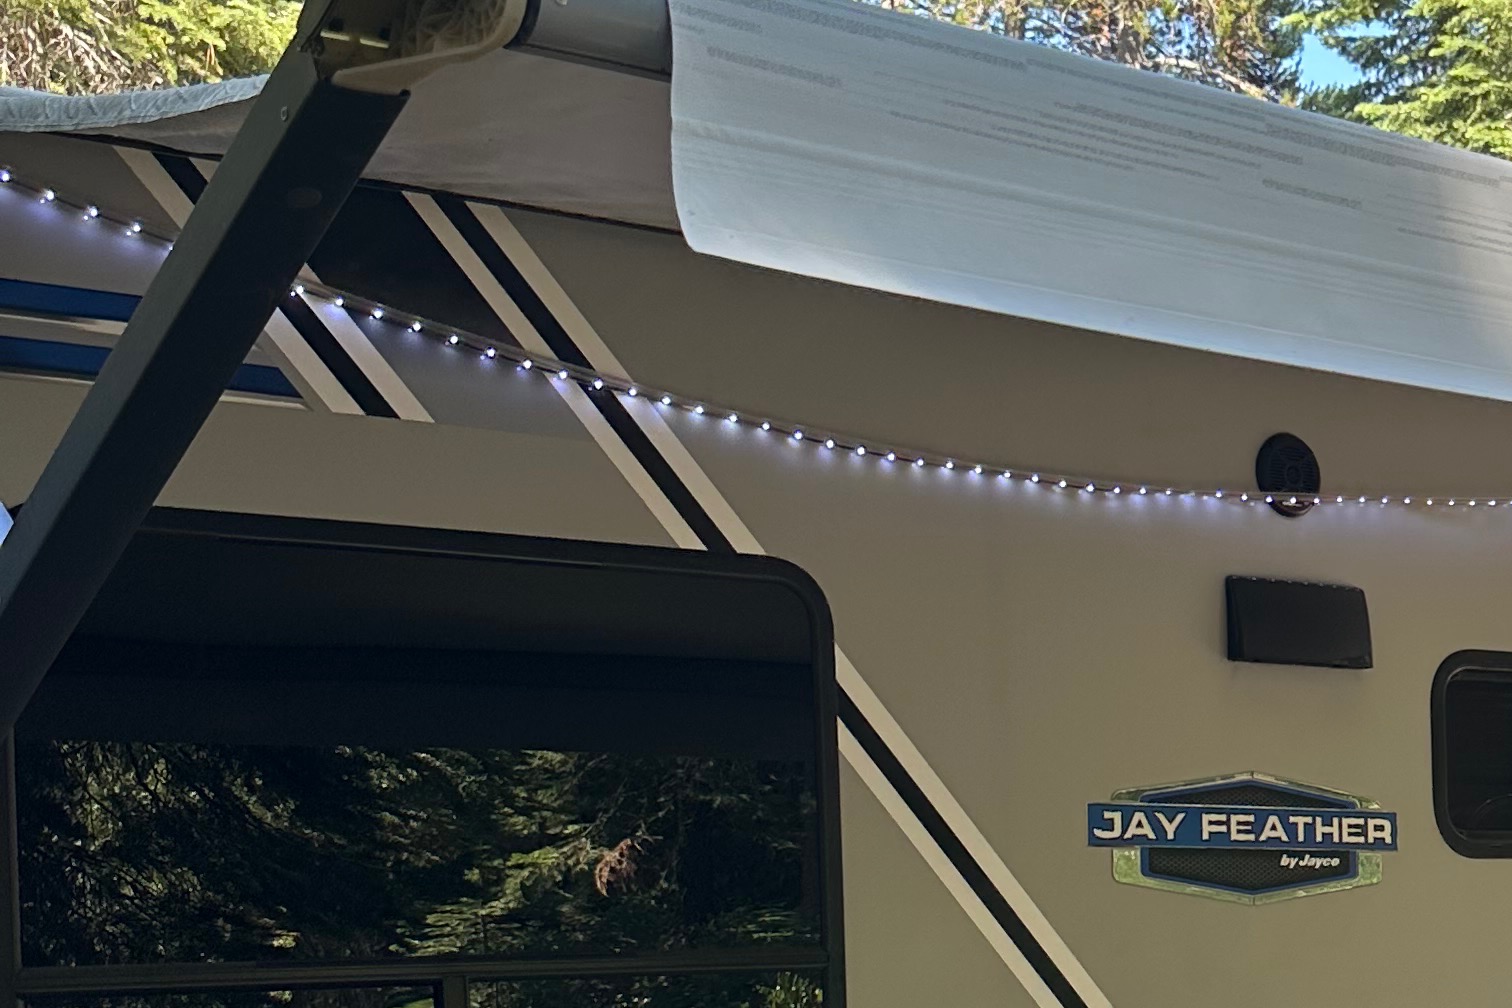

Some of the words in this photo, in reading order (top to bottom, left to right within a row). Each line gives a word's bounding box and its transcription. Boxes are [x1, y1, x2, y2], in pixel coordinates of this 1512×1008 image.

[1093, 810, 1186, 841] JAY
[1201, 812, 1392, 845] FEATHER
[1280, 854, 1298, 869] by
[1299, 854, 1340, 868] Jayco
